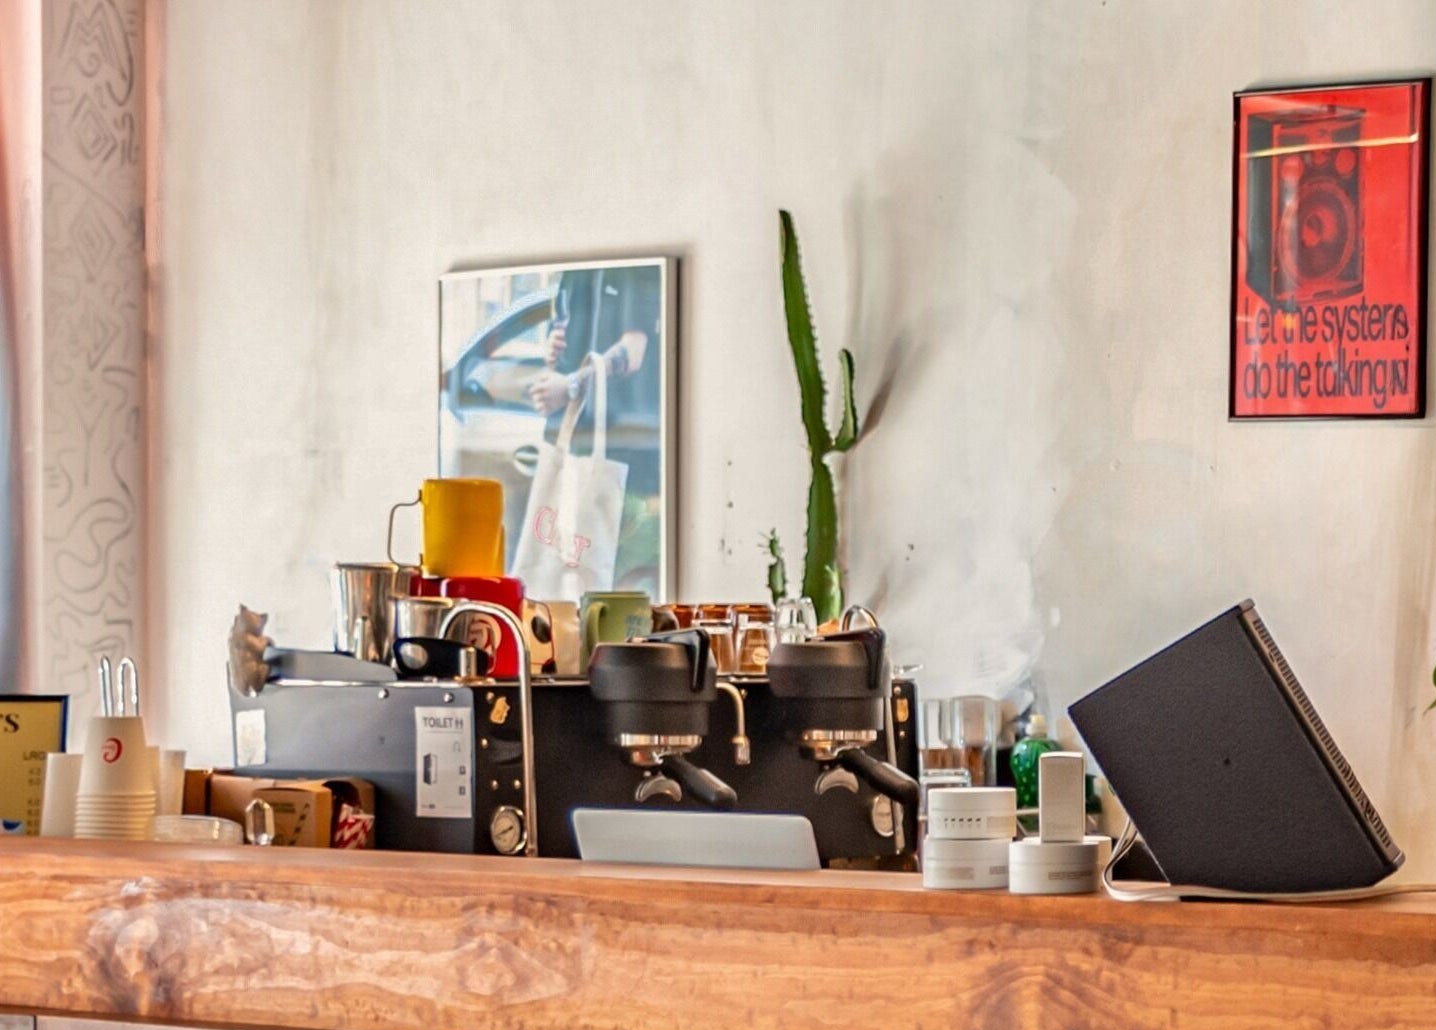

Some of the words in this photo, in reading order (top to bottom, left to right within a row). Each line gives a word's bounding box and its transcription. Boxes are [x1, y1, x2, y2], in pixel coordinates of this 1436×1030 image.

[1244, 296, 1277, 345] Let
[1279, 296, 1318, 344] the
[1244, 349, 1272, 399] do
[1276, 349, 1312, 399] the
[1315, 348, 1387, 410] talking
[0, 713, 20, 733] S
[423, 716, 454, 728] TOILET
